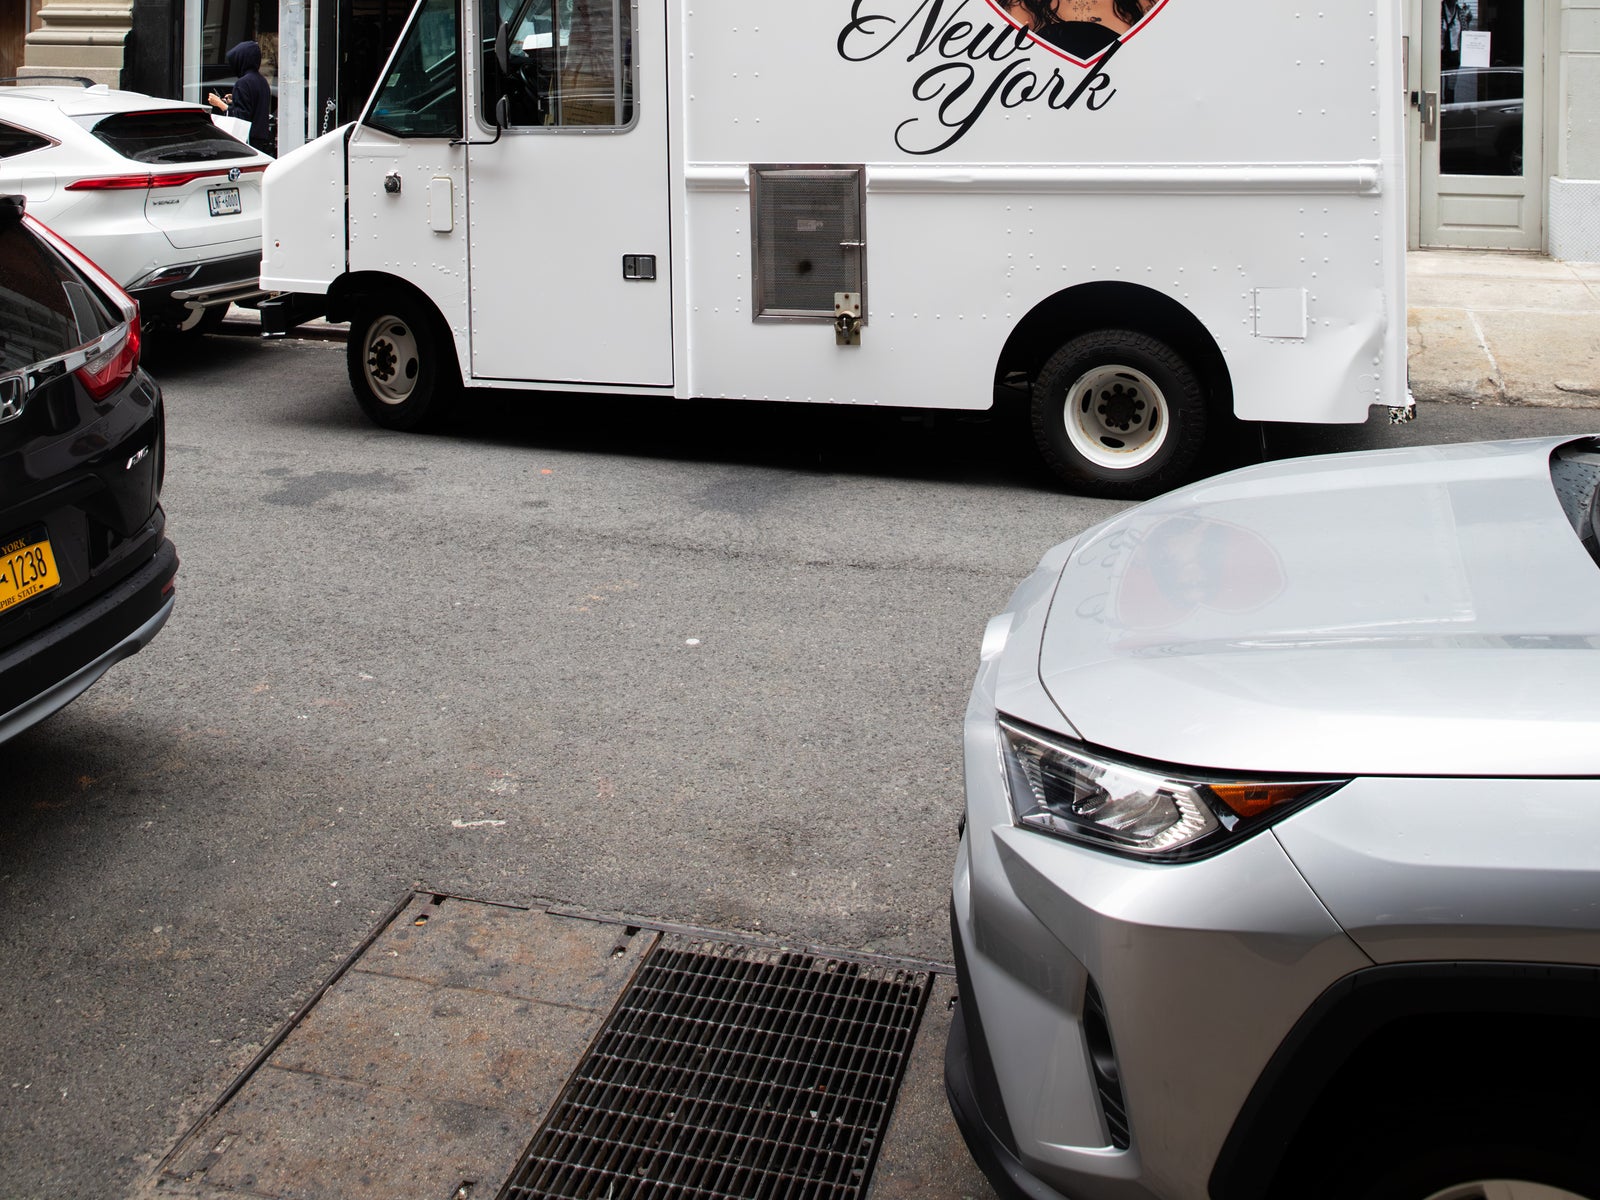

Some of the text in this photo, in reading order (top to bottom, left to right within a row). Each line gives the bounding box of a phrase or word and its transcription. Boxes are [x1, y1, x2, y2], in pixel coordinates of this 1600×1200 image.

[894, 39, 1124, 155] York
[1, 537, 27, 555] YORK
[8, 546, 47, 590] 1238
[0, 583, 38, 609] PIRE STATE
